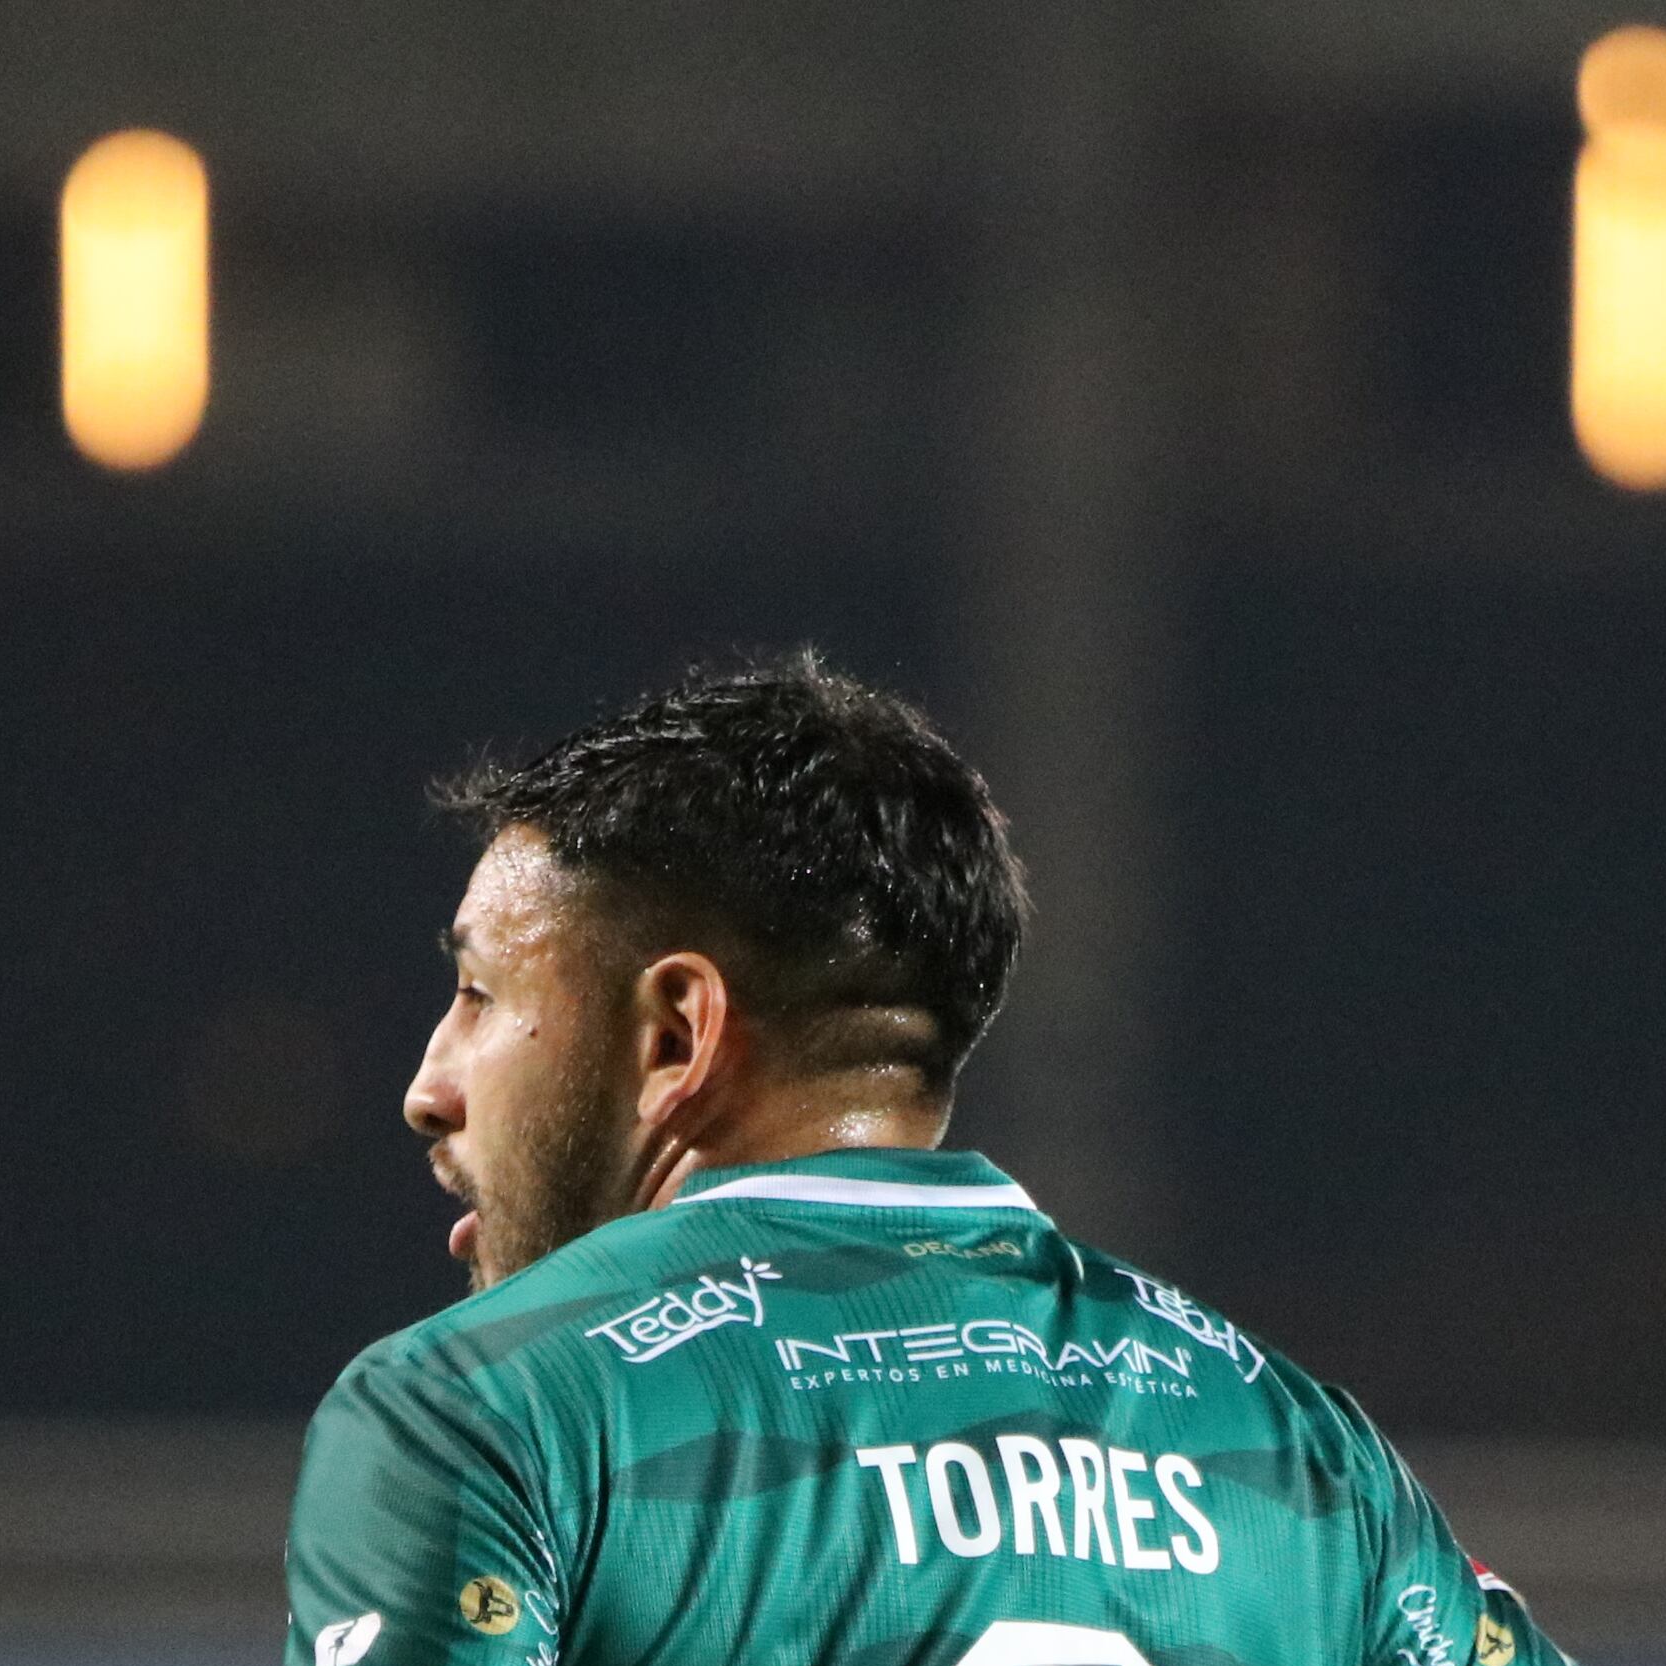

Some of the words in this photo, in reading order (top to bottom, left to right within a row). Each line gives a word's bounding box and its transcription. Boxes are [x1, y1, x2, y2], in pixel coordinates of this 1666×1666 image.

[584, 1256, 783, 1364] Teddy
[789, 1367, 921, 1391] EXPERTOS
[935, 1362, 970, 1380] EN
[984, 1358, 1093, 1387] MEDICINA
[855, 1435, 1221, 1576] TORRES
